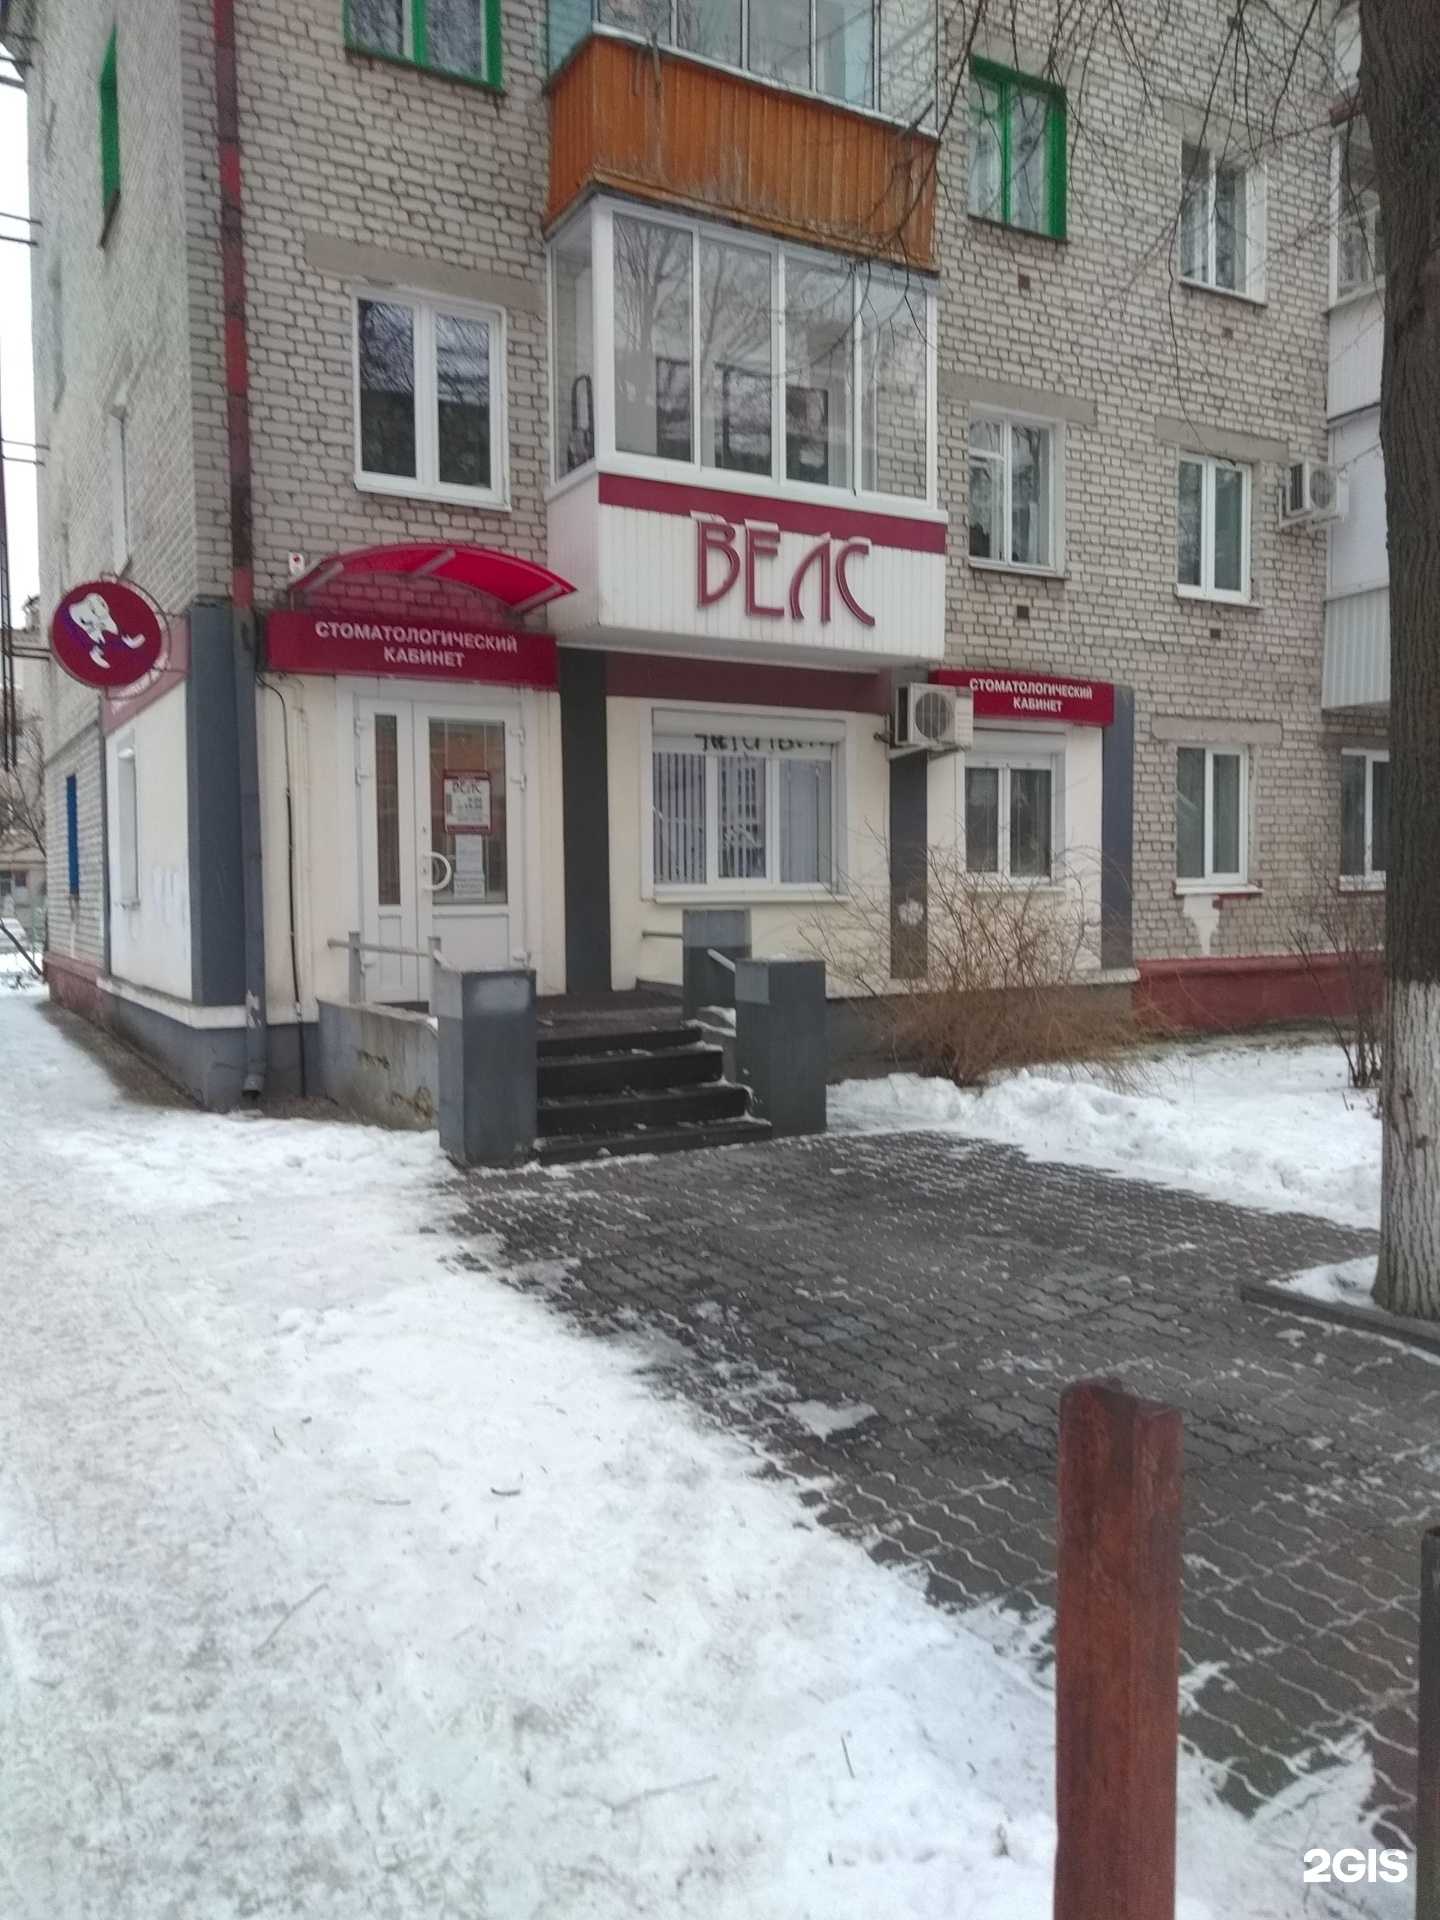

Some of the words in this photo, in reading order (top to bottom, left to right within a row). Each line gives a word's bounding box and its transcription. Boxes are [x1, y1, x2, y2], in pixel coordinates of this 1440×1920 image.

[695, 514, 876, 627] ВЕЛС
[315, 621, 518, 653] СТОМАТОЛОГИЧЕСКИЙ
[384, 646, 465, 668] КАБИНЕТ
[969, 678, 1093, 700] СТОМАТОЛОГИЧЕСКИЙ
[1013, 696, 1063, 712] КАБИНЕТ
